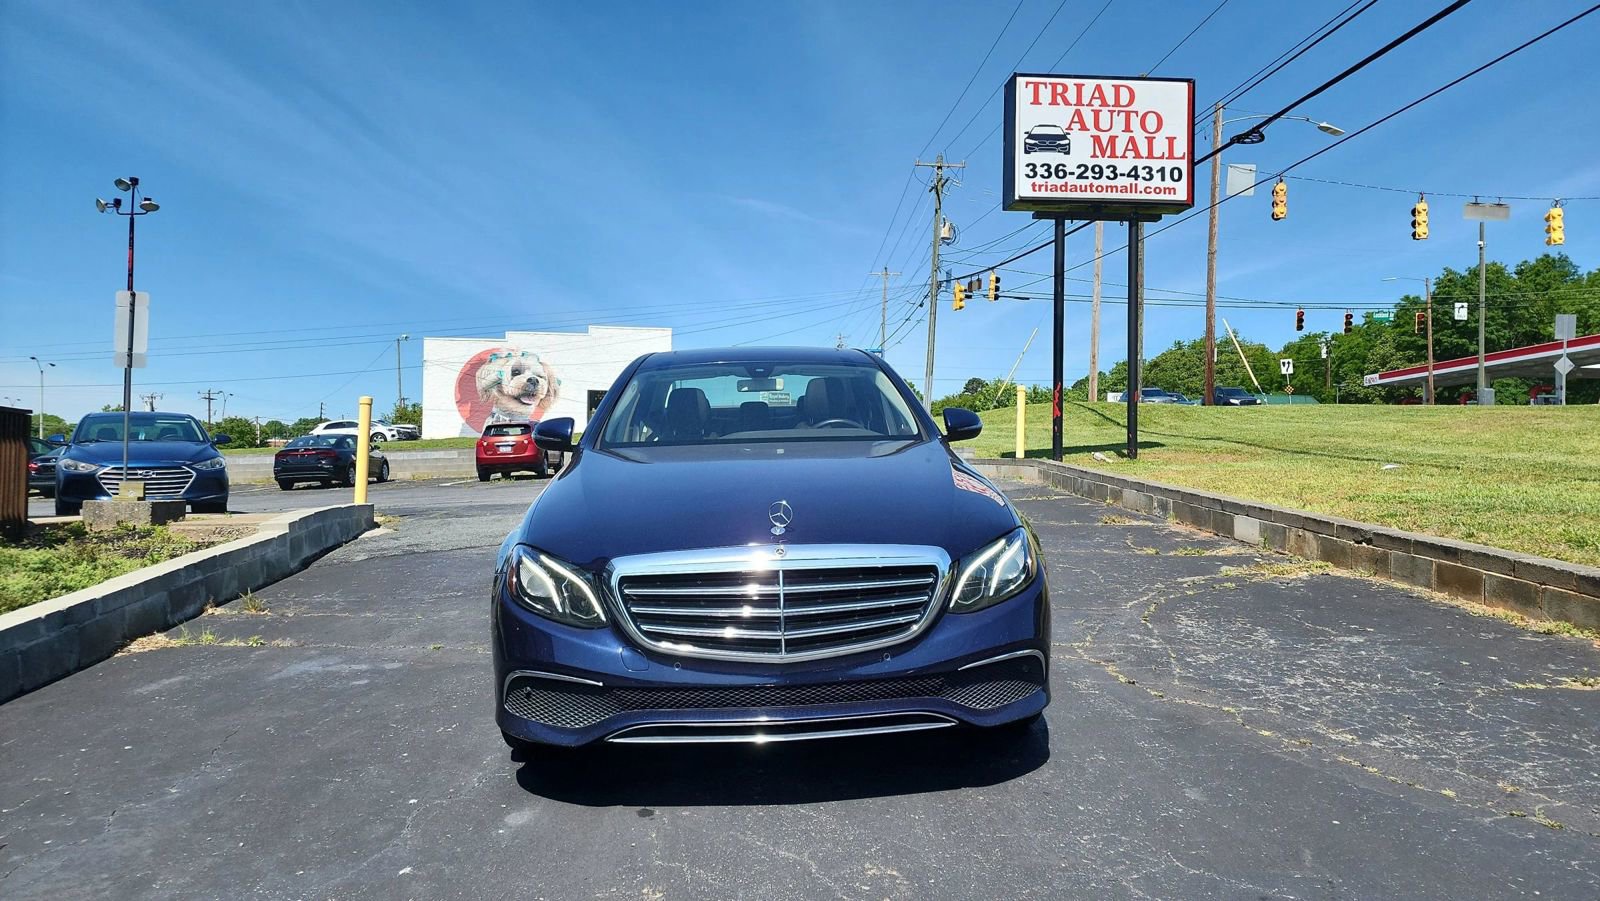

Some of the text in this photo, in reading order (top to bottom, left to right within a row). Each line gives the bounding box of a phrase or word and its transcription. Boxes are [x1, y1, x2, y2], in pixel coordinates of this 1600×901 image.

[1025, 81, 1136, 108] TRIAD
[1065, 109, 1164, 134] AUTO
[1090, 134, 1186, 160] MALL
[1024, 162, 1183, 183] 336-293-4310
[1031, 181, 1177, 195] triadautomall.com
